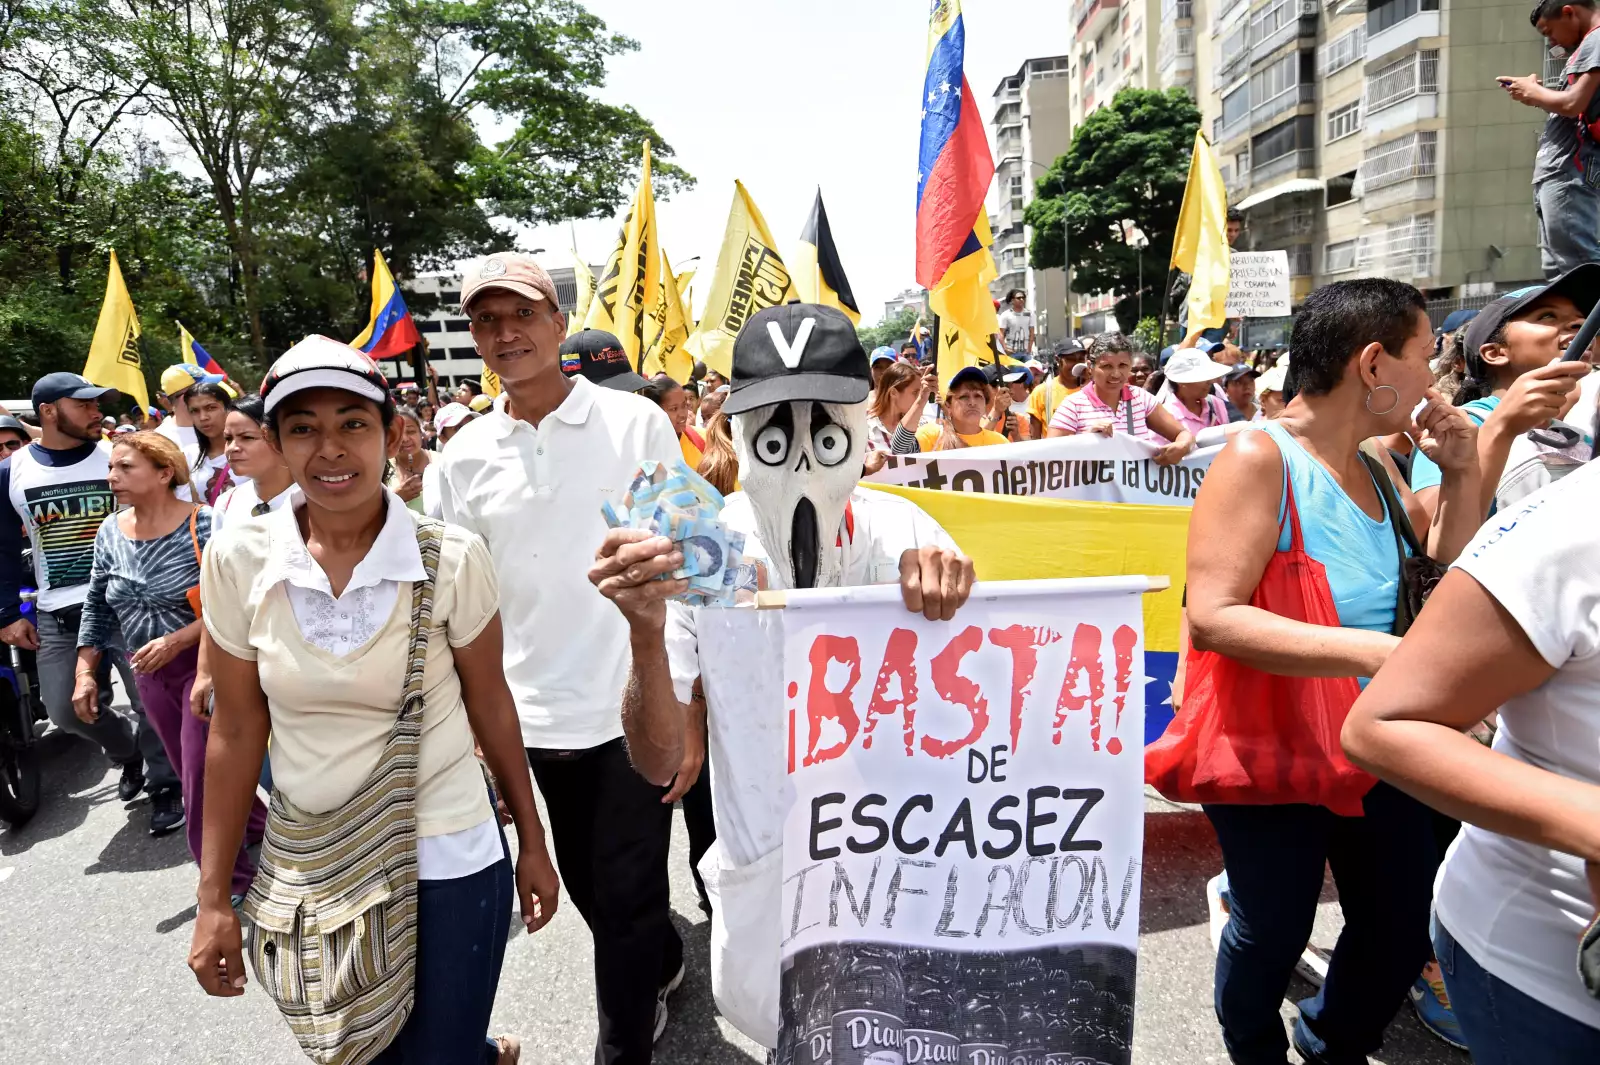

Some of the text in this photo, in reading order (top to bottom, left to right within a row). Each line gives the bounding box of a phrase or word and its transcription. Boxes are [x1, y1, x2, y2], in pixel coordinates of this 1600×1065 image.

[766, 317, 816, 368] V
[41, 488, 69, 497] ANOTHER
[1144, 459, 1211, 500] Cons
[787, 622, 1138, 774] ¡BASTA!
[967, 744, 1008, 784] DE
[809, 786, 1104, 861] ESCASEZ
[781, 854, 1141, 947] INFLACION
